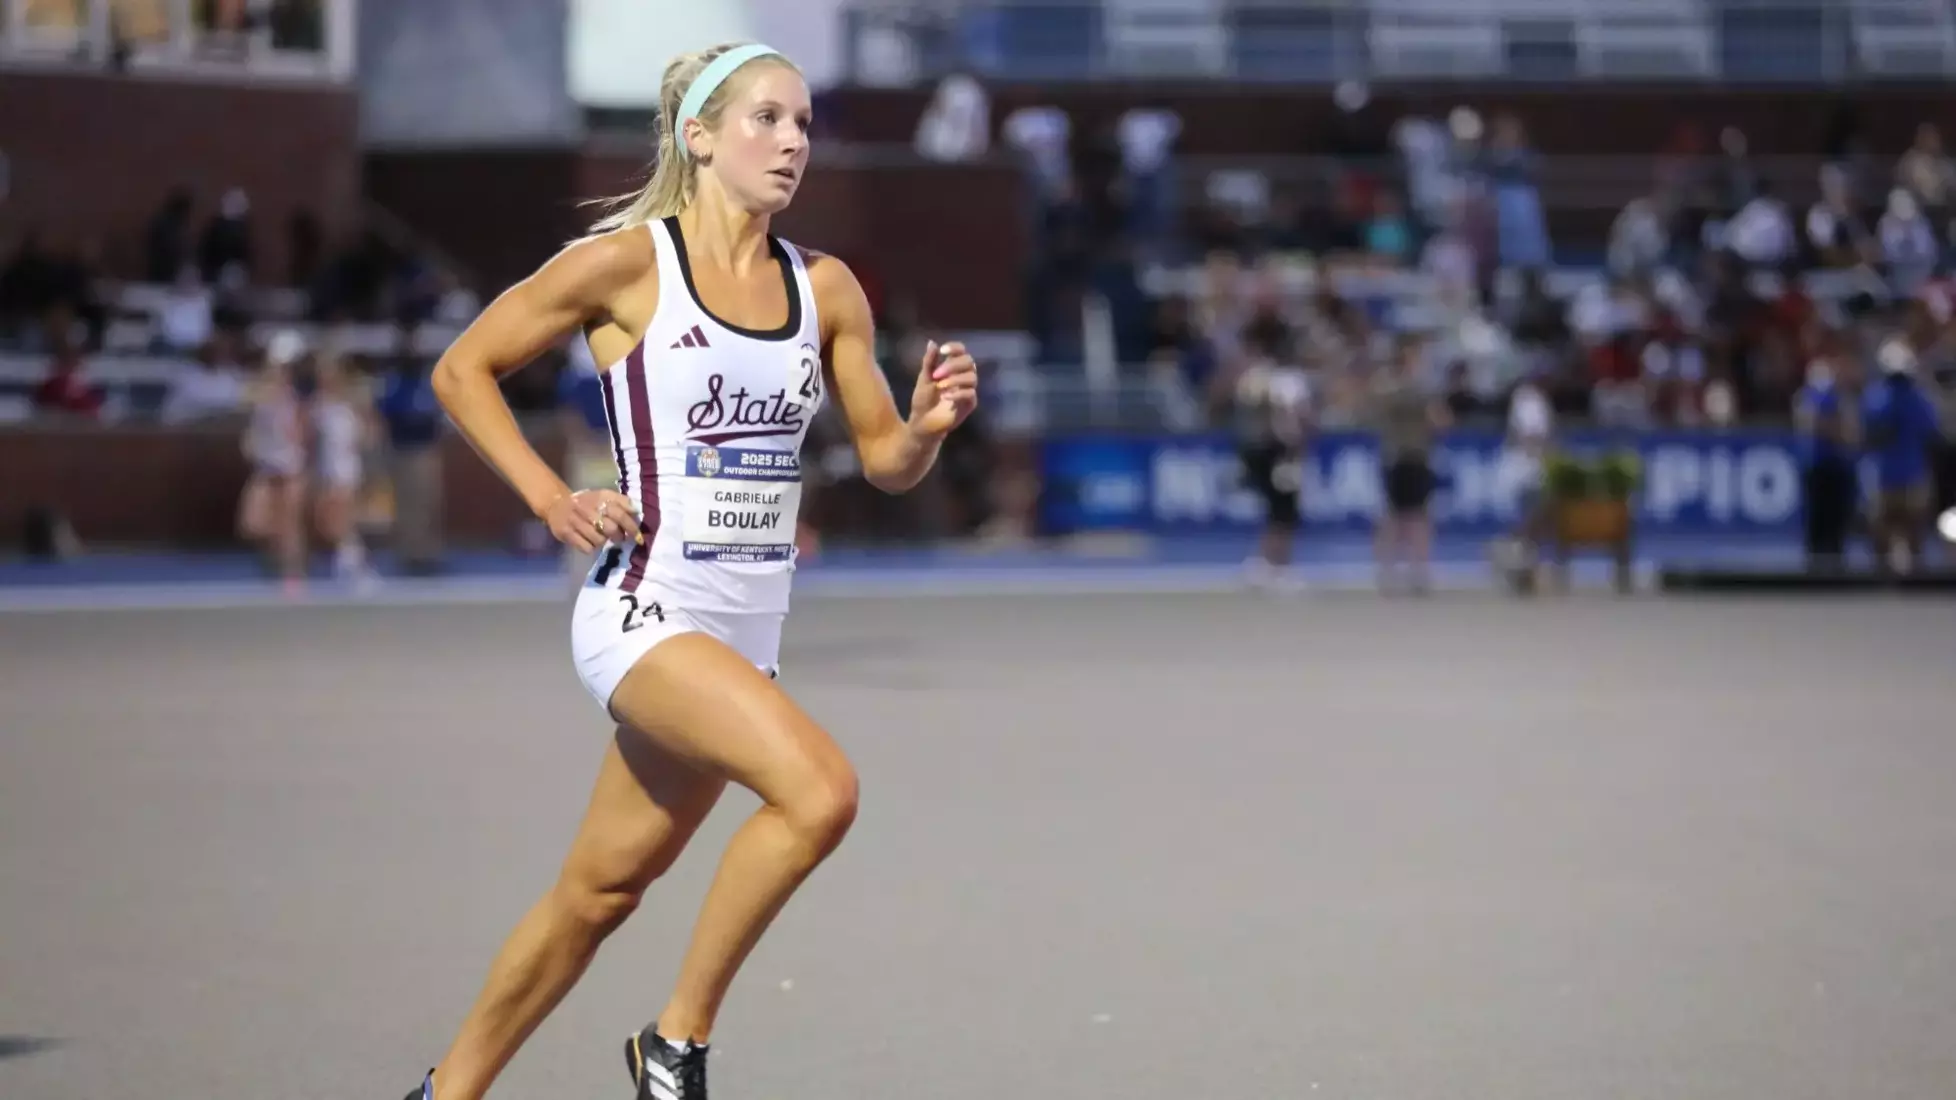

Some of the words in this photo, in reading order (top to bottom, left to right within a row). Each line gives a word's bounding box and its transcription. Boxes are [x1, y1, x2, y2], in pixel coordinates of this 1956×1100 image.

[799, 357, 821, 402] 24
[686, 373, 804, 434] State
[740, 453, 772, 466] 2025
[774, 455, 796, 467] SEC
[724, 466, 758, 476] OUTDOOR
[714, 491, 781, 504] GABRIELLE
[708, 509, 781, 530] BOULAY
[688, 543, 731, 553] UNIVERSITY
[731, 545, 740, 553] OF
[619, 594, 665, 634] 24
